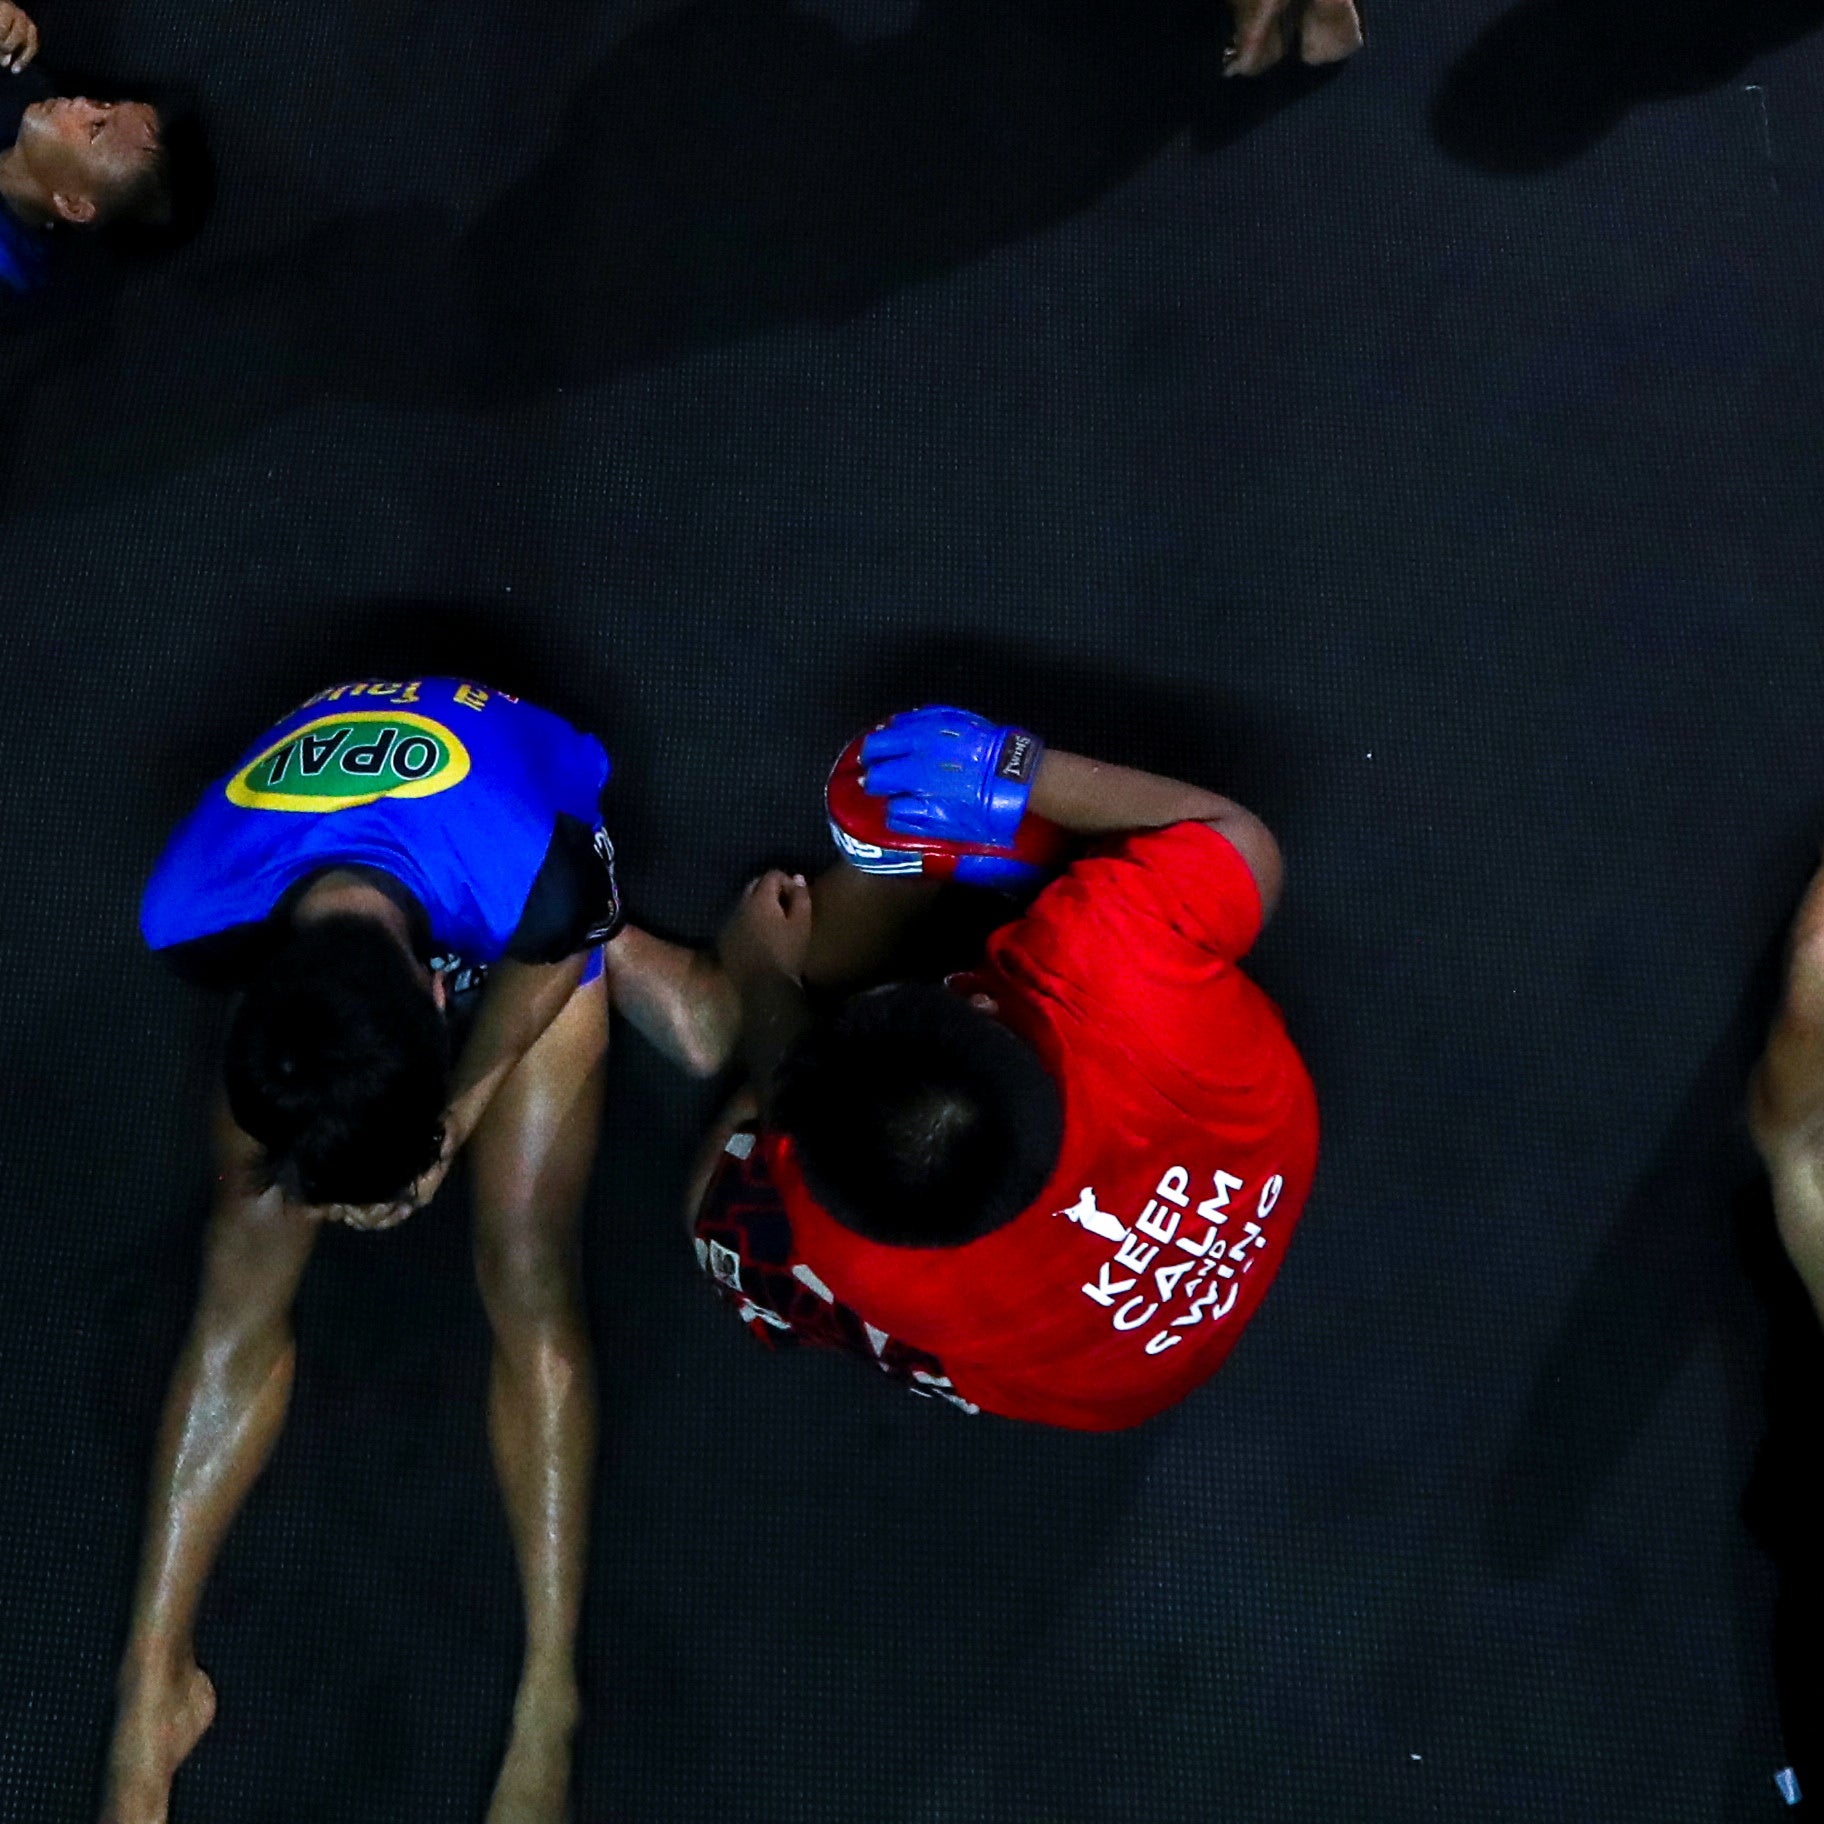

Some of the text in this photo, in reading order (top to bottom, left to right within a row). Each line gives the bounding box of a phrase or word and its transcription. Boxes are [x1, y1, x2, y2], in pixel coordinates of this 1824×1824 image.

[267, 727, 439, 786] OPAL
[1081, 1165, 1191, 1307] KEEP
[1112, 1169, 1244, 1331] CALM
[1184, 1239, 1226, 1298] AND
